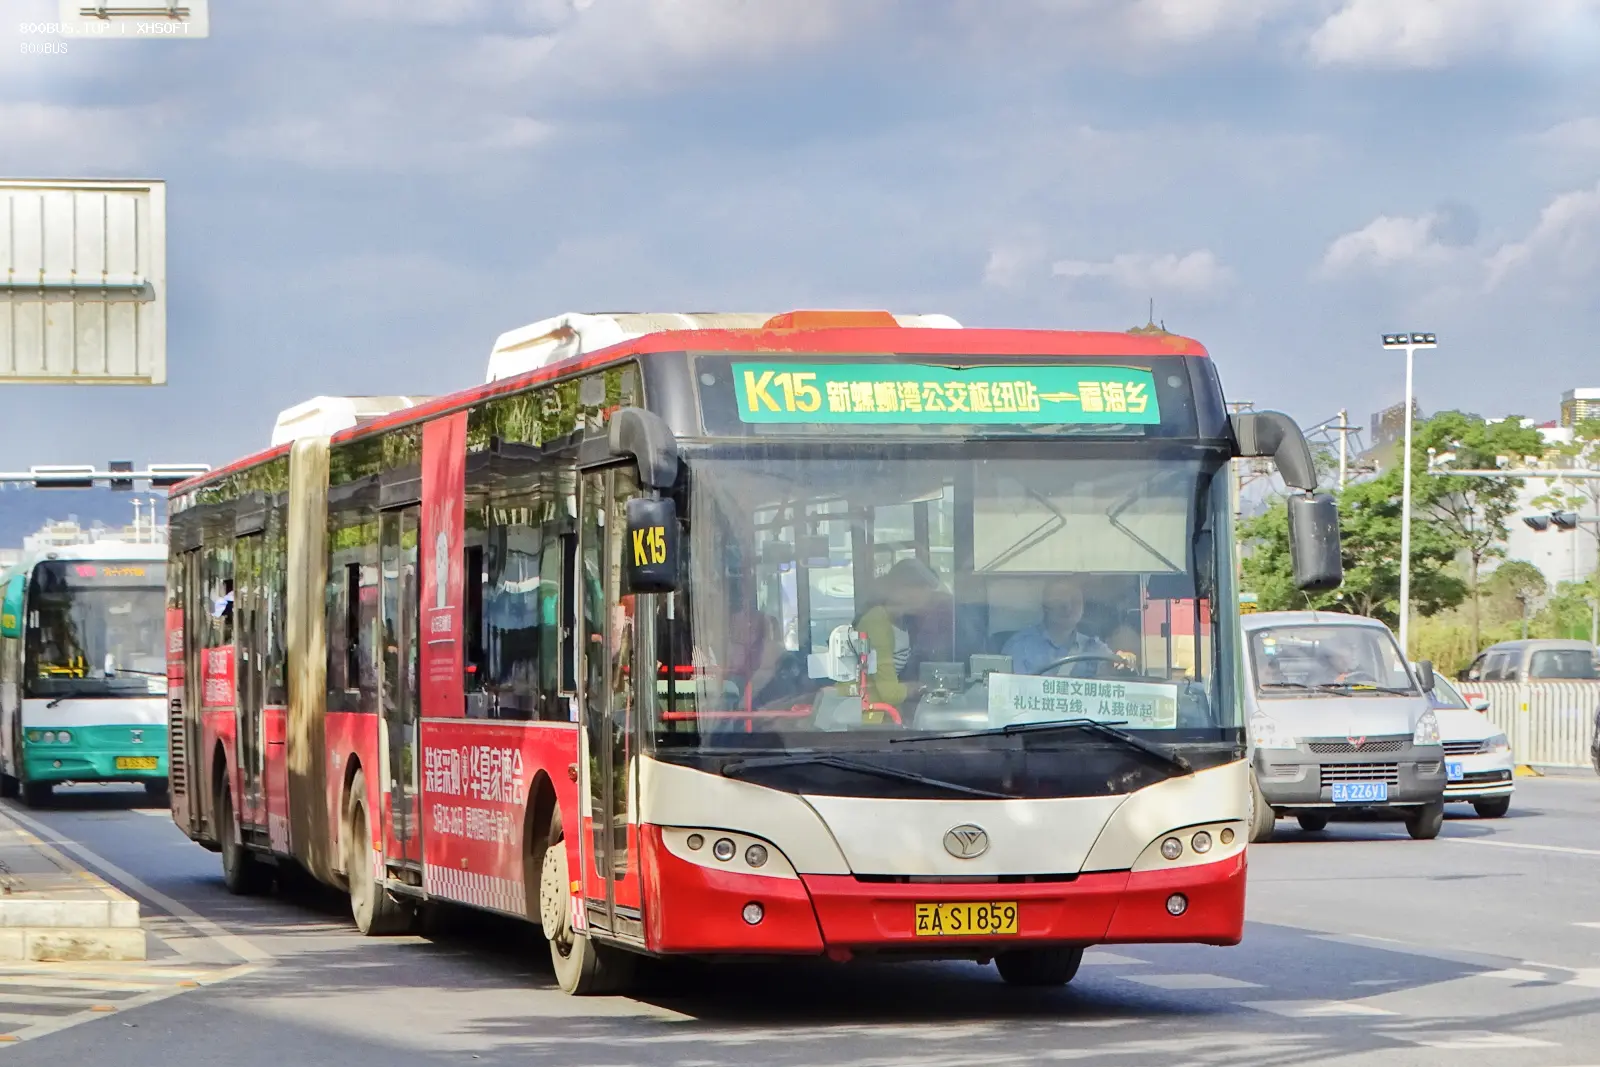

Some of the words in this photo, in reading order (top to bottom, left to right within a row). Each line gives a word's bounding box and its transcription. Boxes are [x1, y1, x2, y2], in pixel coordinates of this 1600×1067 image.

[744, 371, 822, 413] K15
[632, 526, 666, 567] K15
[1042, 679, 1126, 698] 创建文明城市
